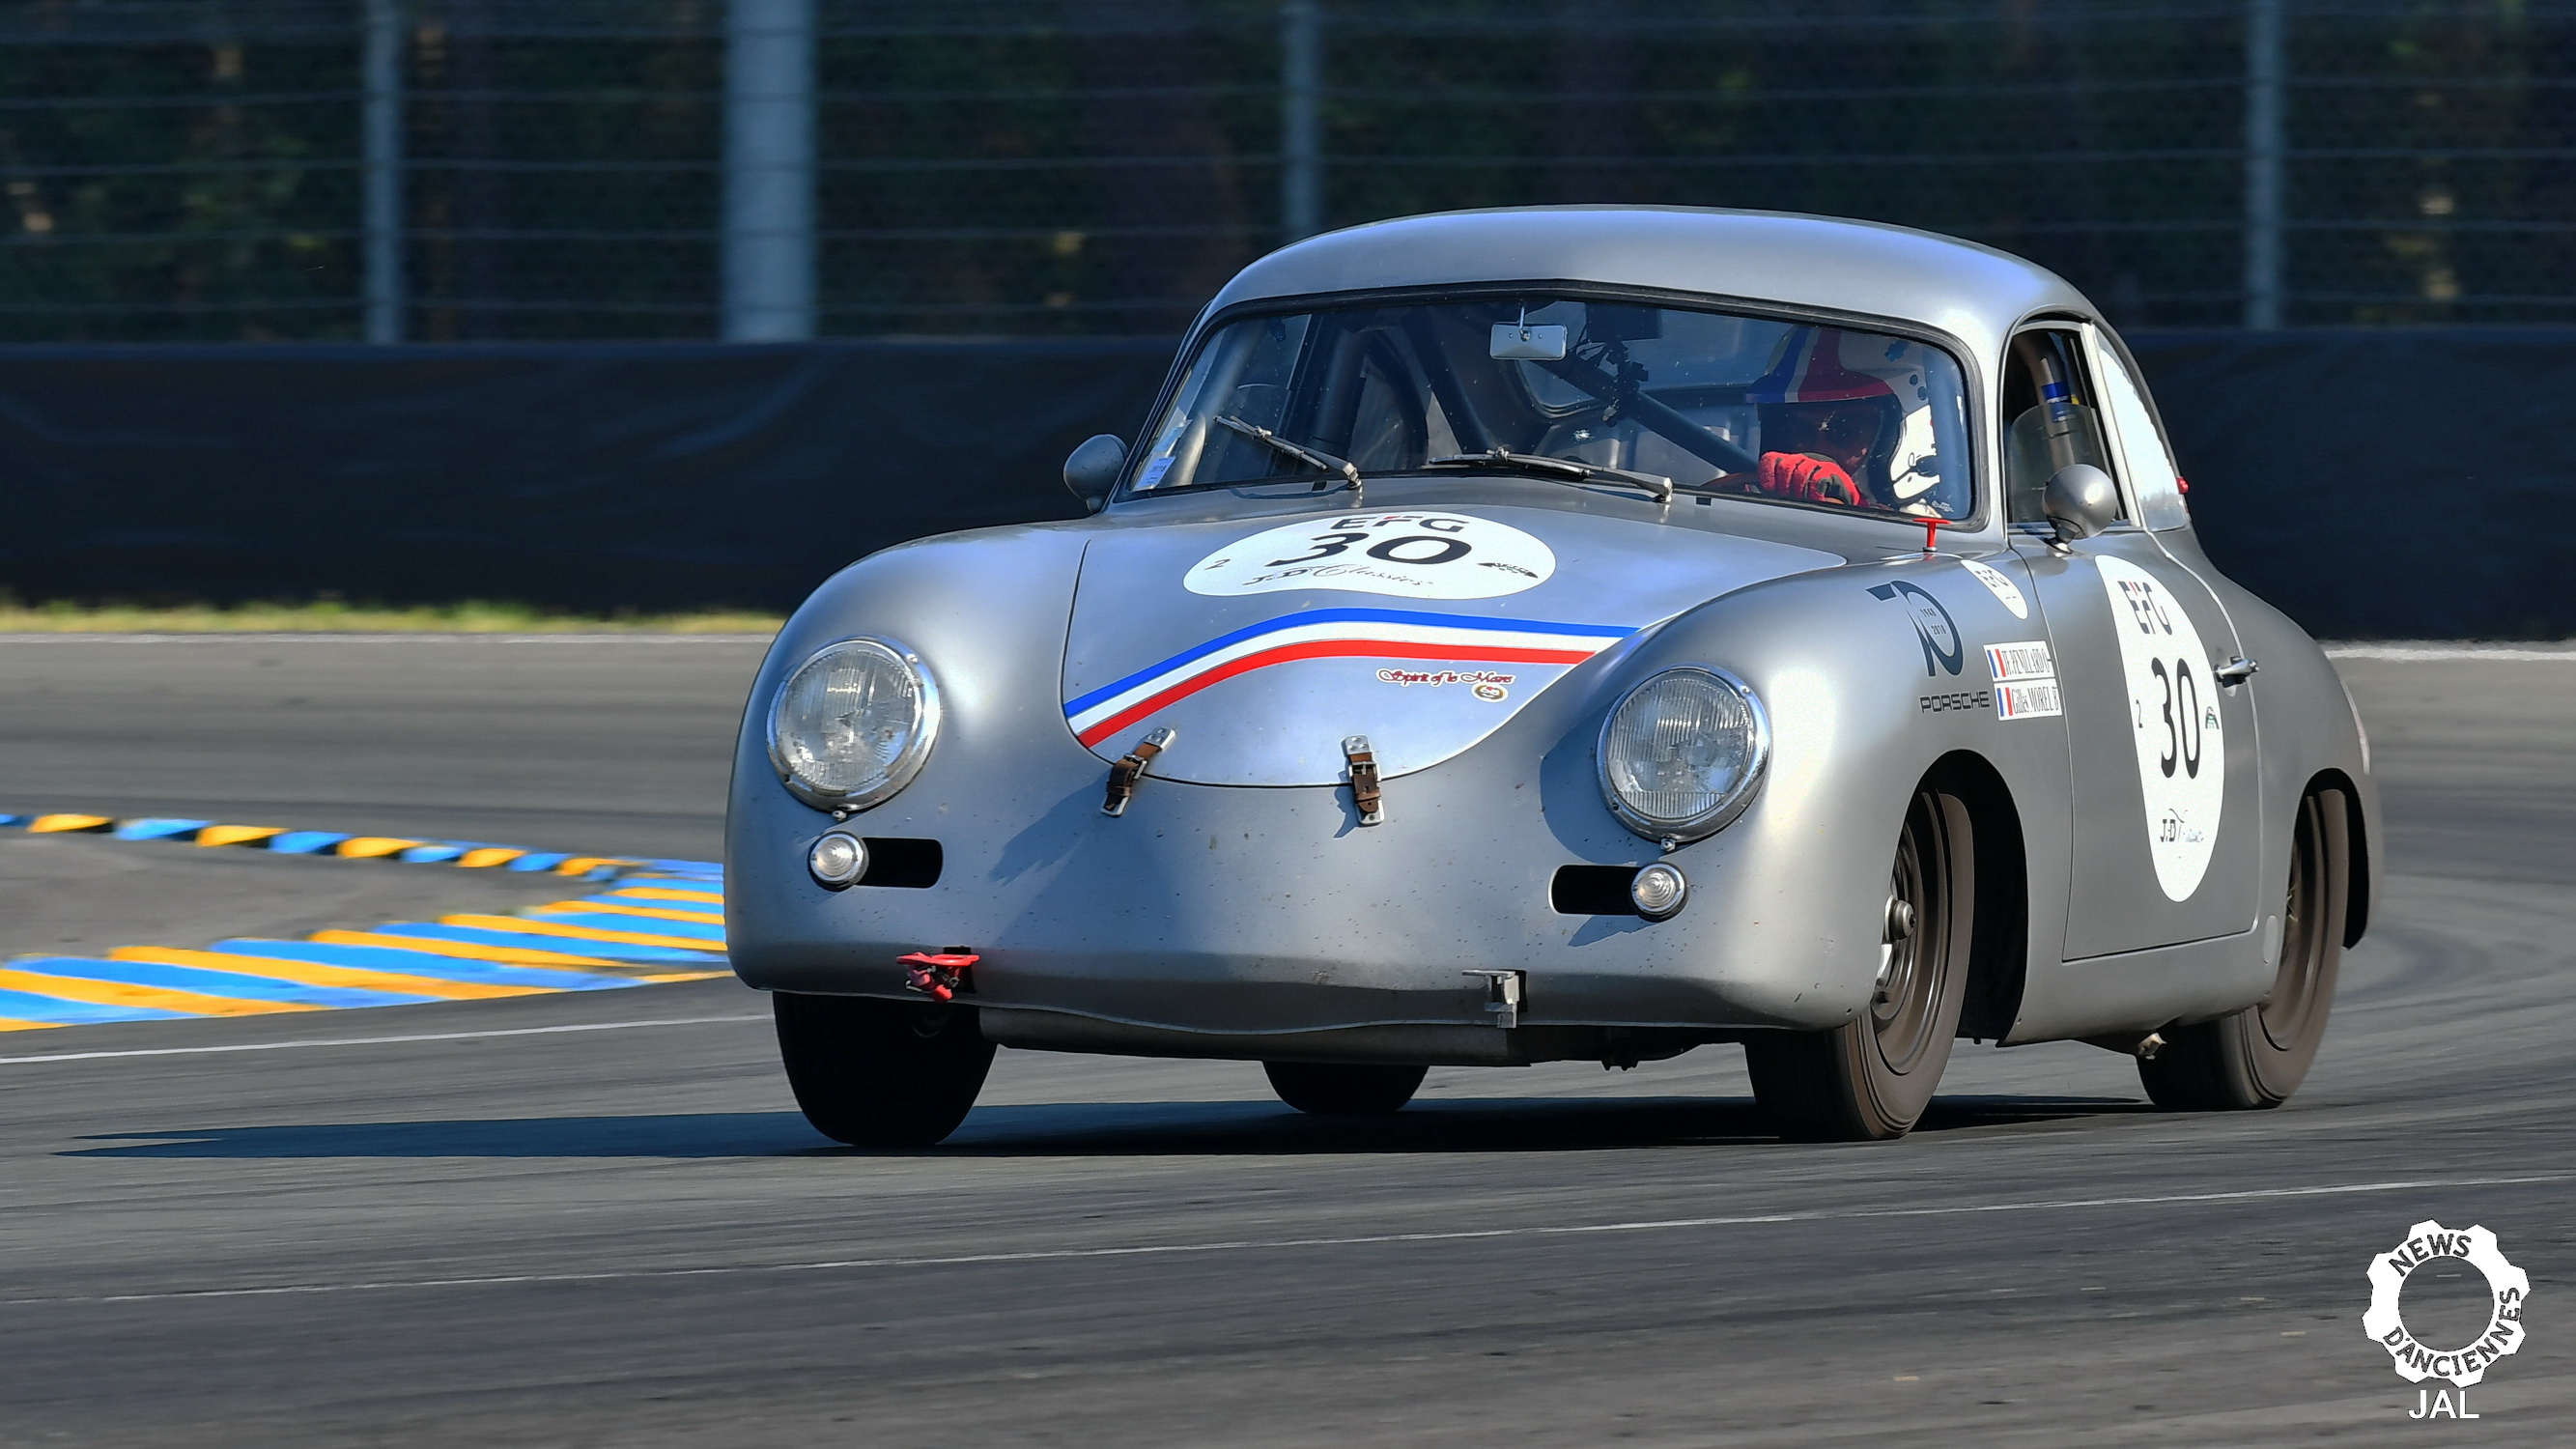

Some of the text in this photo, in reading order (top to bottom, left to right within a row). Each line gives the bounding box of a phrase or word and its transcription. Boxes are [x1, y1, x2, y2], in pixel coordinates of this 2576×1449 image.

[1330, 515, 1469, 532] EFG
[1263, 532, 1472, 565] 30
[2117, 581, 2172, 636] EFG
[1378, 670, 1430, 686] Spirit
[1431, 672, 1446, 686] of
[1460, 672, 1514, 683] Mans
[1920, 691, 1990, 714] PORSCHE
[2151, 657, 2200, 779] 30
